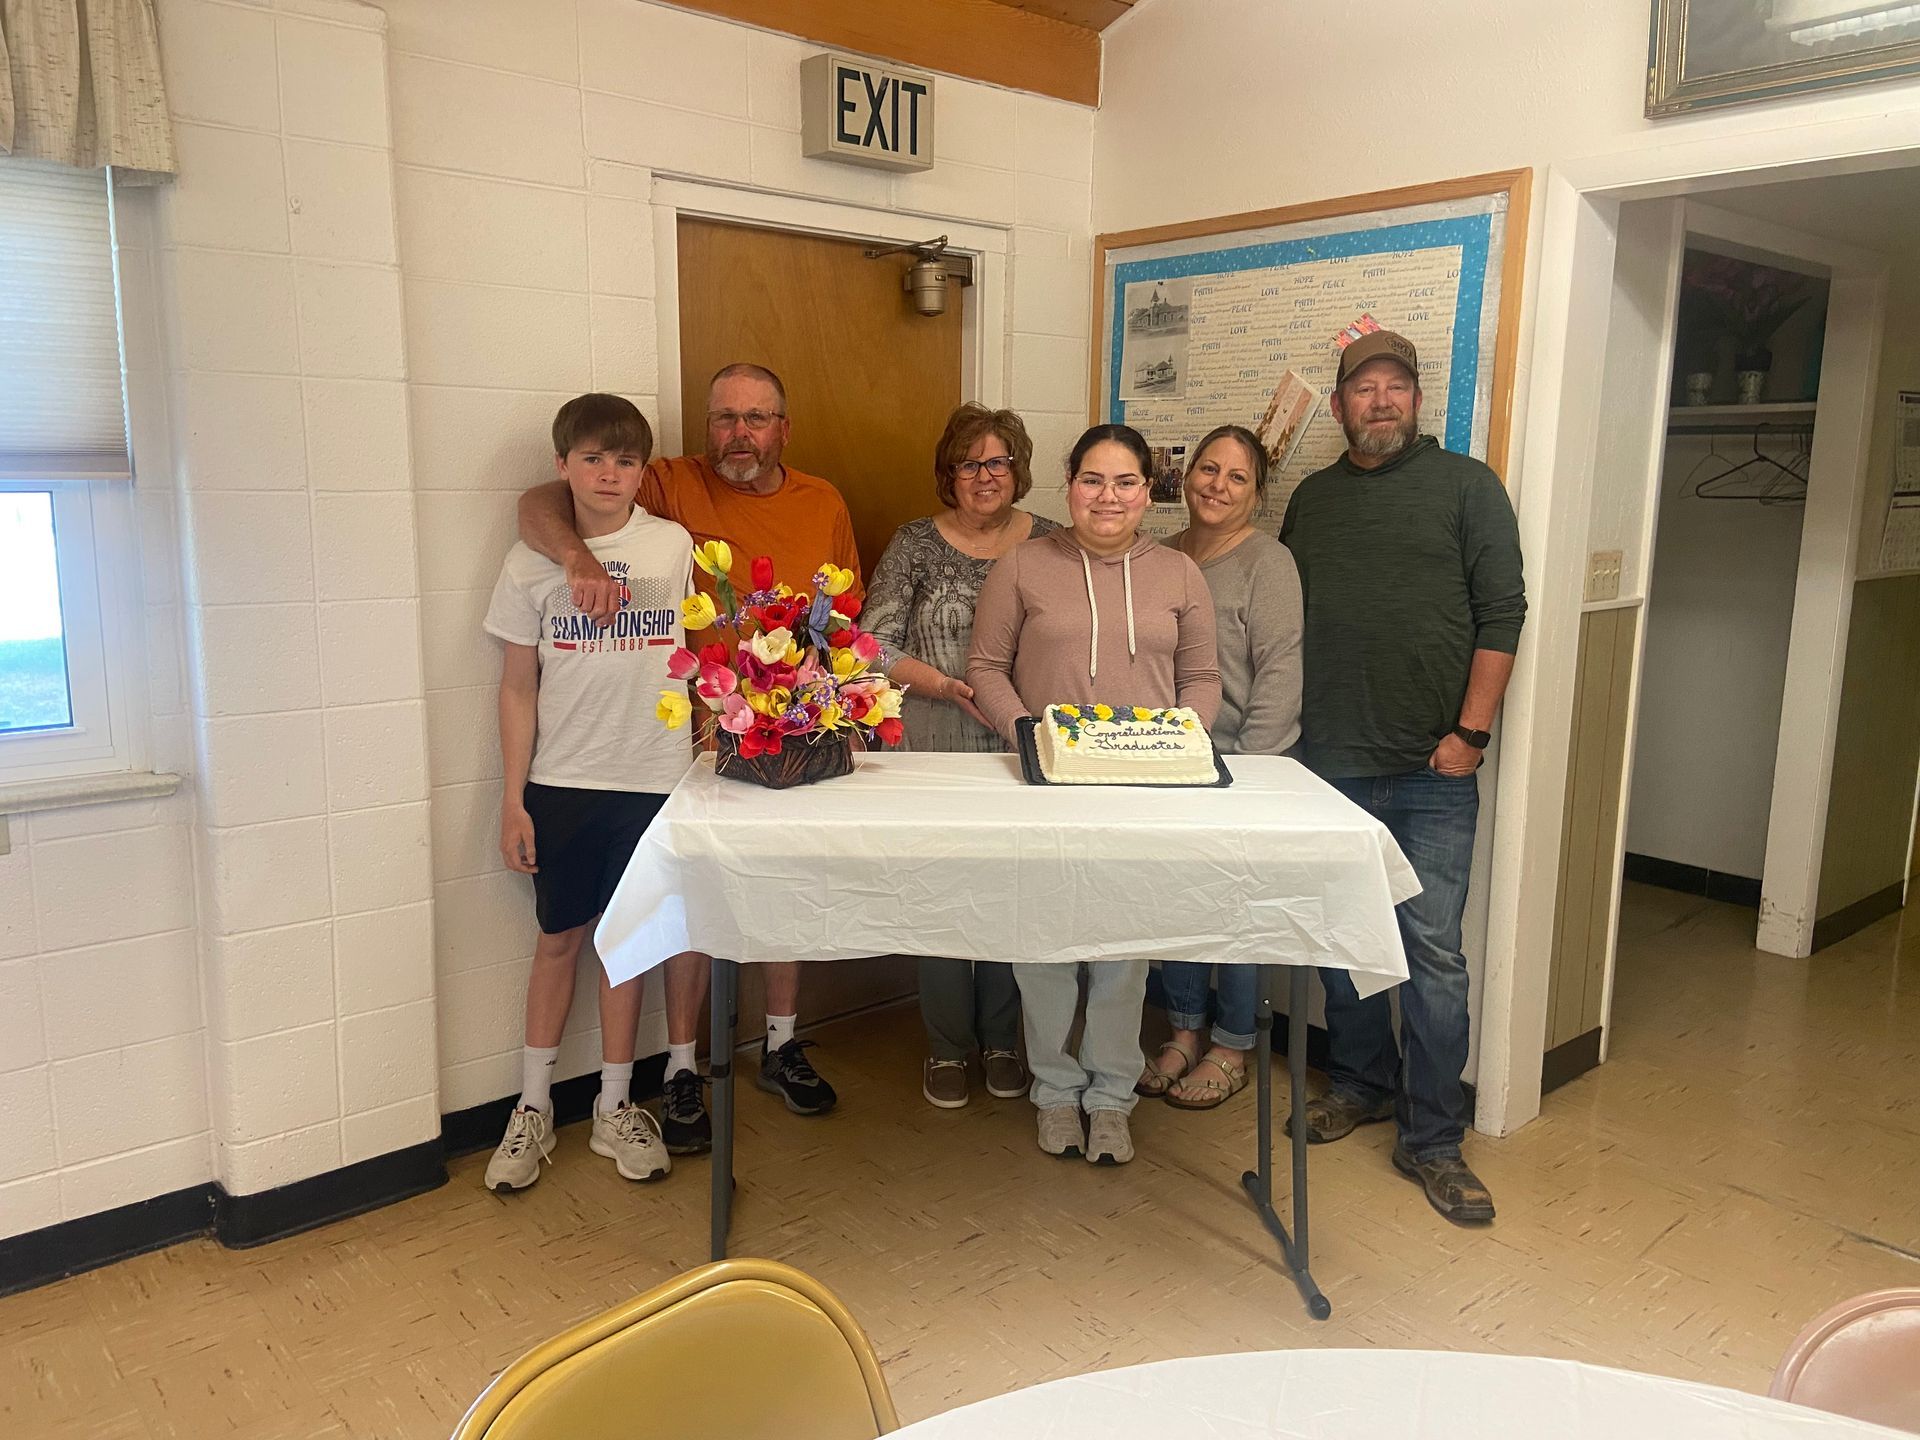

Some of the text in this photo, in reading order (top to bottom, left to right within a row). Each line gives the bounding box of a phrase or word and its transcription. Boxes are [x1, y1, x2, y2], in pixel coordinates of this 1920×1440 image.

[837, 66, 927, 156] EXIT
[1362, 267, 1386, 279] FAITH
[1294, 275, 1315, 285] HOPE
[1322, 278, 1345, 289] PEACE
[1194, 287, 1213, 297] FAITH
[1261, 287, 1280, 297] LOVE
[1408, 286, 1436, 298] PEACE
[1231, 303, 1253, 314] PEACE
[1294, 298, 1316, 309] FAITH
[1354, 299, 1378, 310] HOPE
[1407, 311, 1431, 322] LOVE
[1229, 325, 1249, 335] LOVE
[1289, 319, 1313, 330] PEACE
[1202, 341, 1221, 351] FAITH
[1262, 338, 1282, 347] FAITH
[1310, 341, 1331, 351] HOPE
[1269, 352, 1288, 361] LOVE
[1301, 365, 1323, 376] FAITH
[1418, 360, 1443, 371] FAITH
[1238, 369, 1259, 379] FAITH
[1186, 406, 1205, 416] FAITH
[1155, 413, 1174, 423] PEACE
[613, 638, 644, 652] 1888
[1084, 723, 1186, 741] Congratulations
[1089, 737, 1186, 751] Graduates
